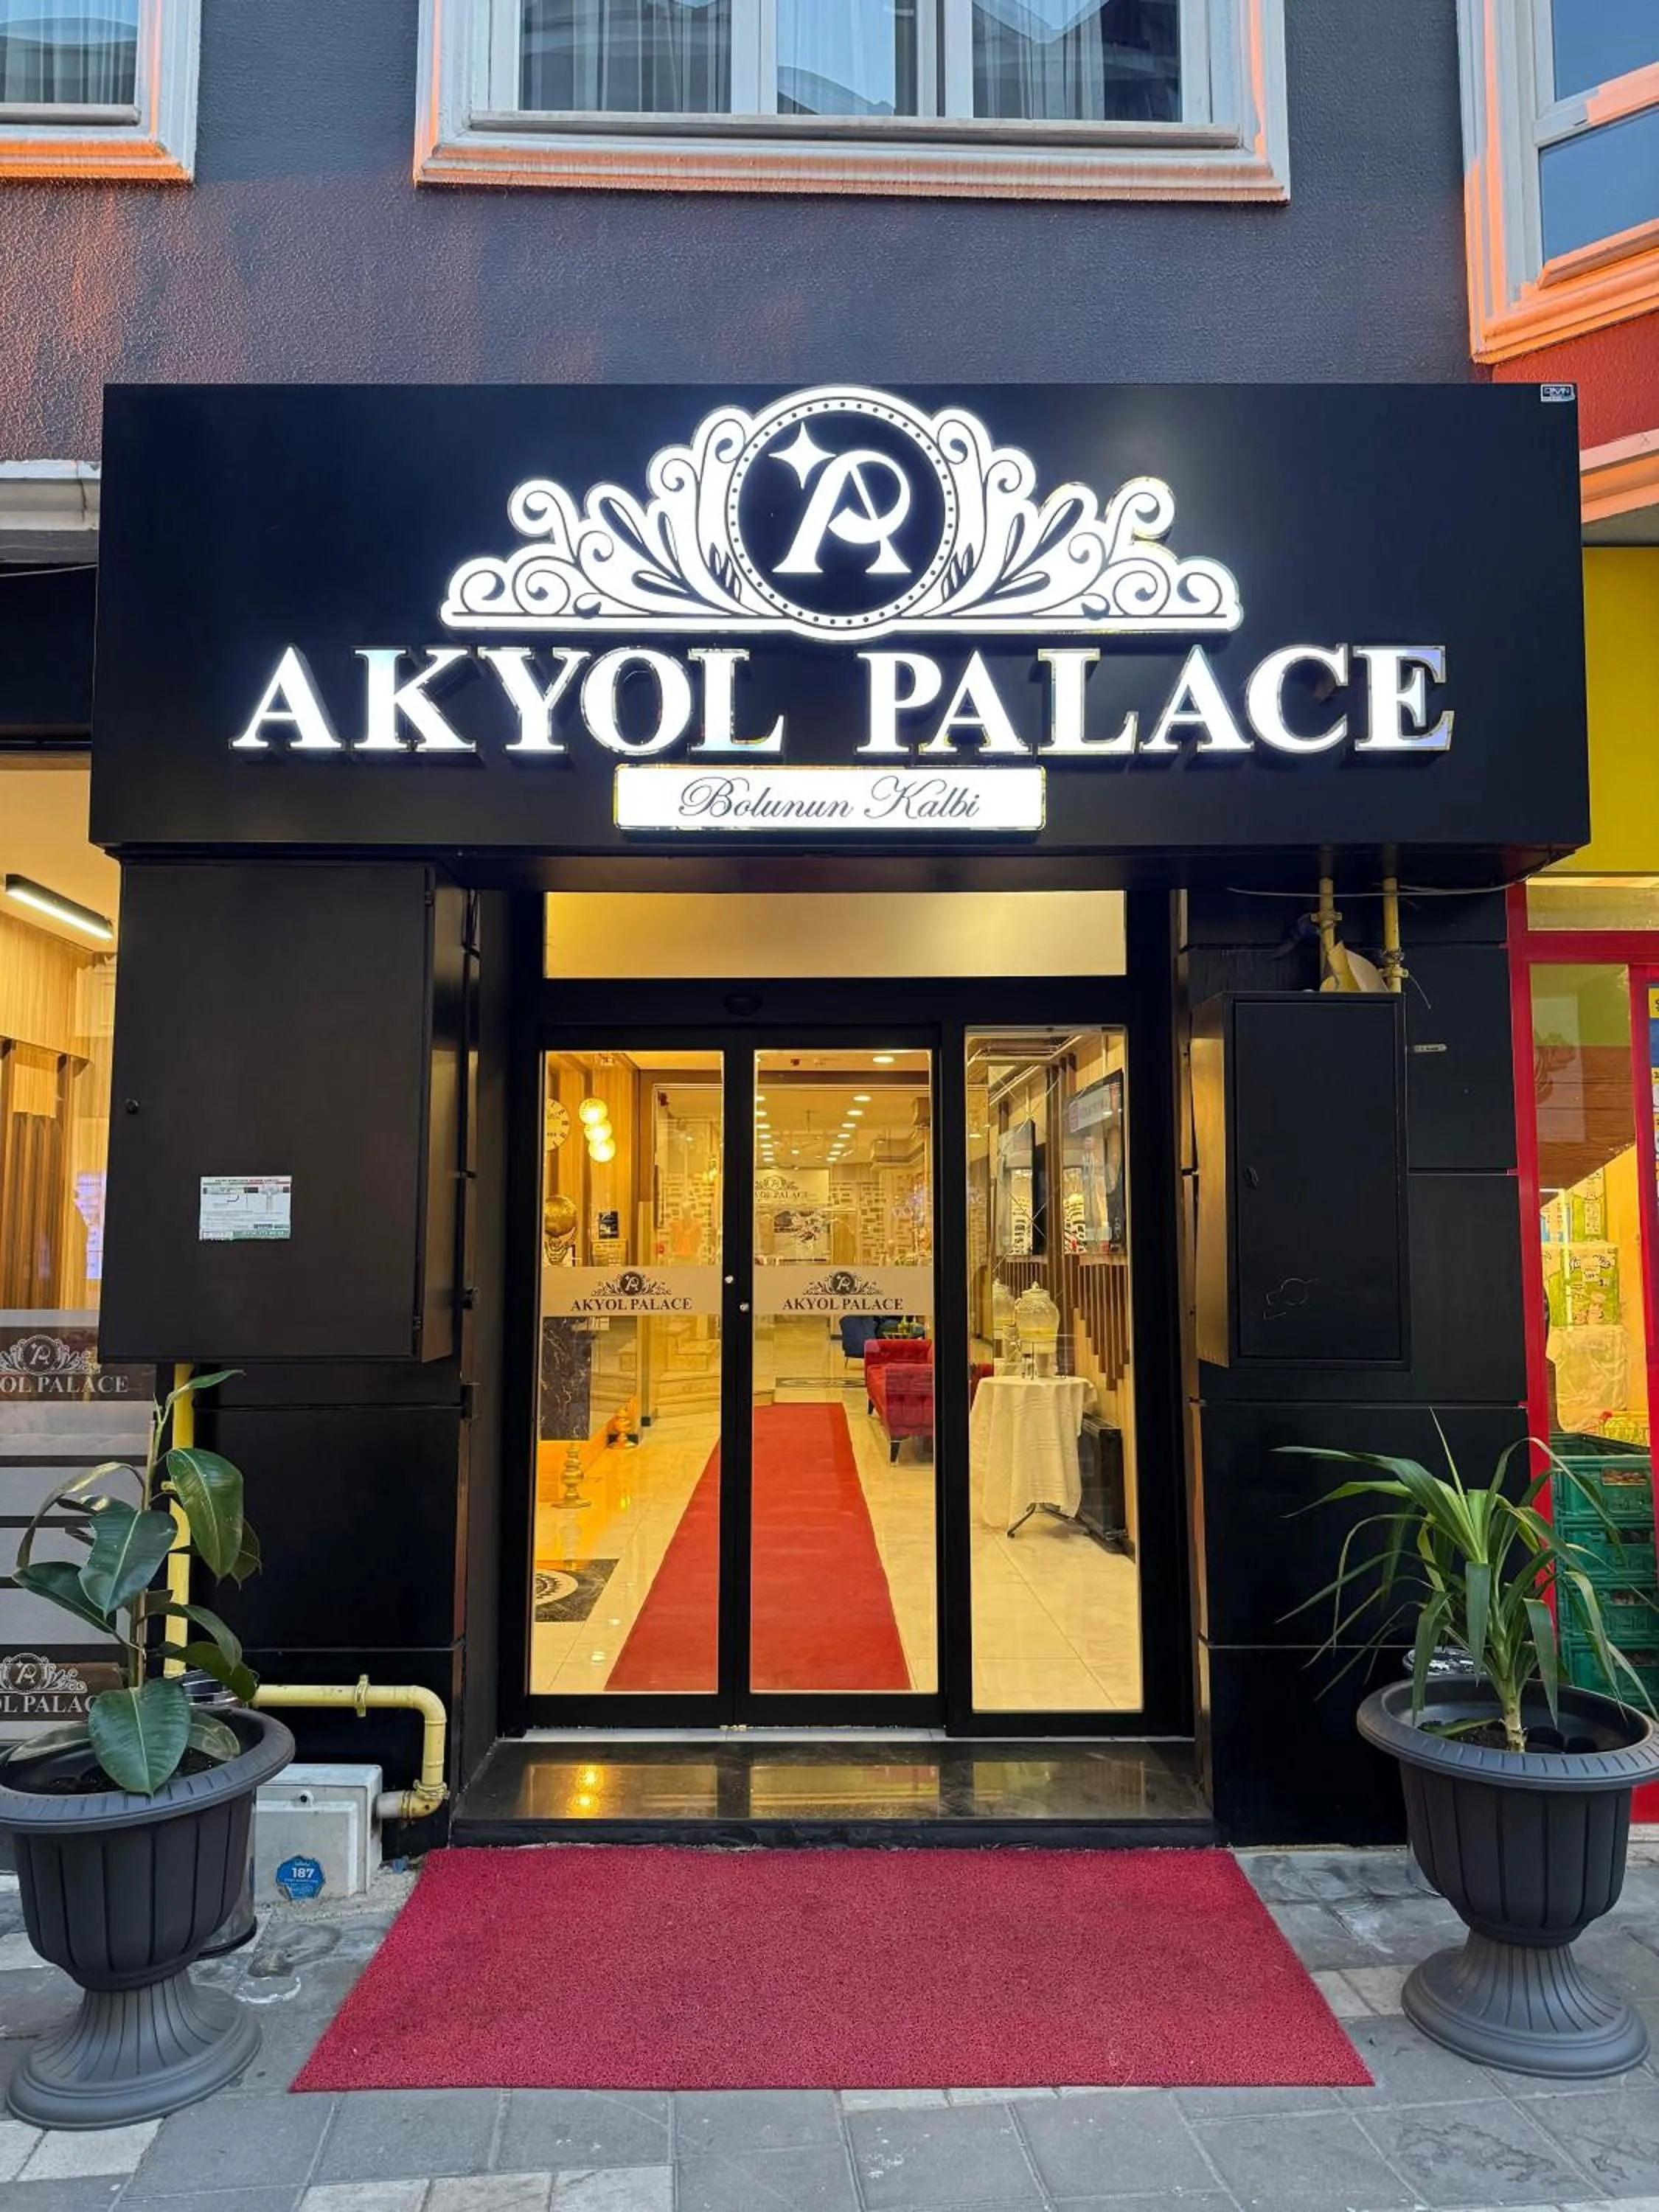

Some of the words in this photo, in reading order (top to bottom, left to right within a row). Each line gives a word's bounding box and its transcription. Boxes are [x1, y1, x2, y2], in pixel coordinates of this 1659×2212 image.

[229, 645, 787, 757] AKYOL
[853, 644, 1457, 756] PALACE
[678, 776, 854, 818] Bolunun
[863, 775, 980, 820] Kalbi
[571, 1297, 627, 1311] AKYOL
[630, 1297, 692, 1310] PALACE
[782, 1298, 838, 1310] AKYOL
[842, 1298, 903, 1310] PALACE
[37, 1374, 129, 1394] PALACE
[291, 1868, 316, 1879] 187
